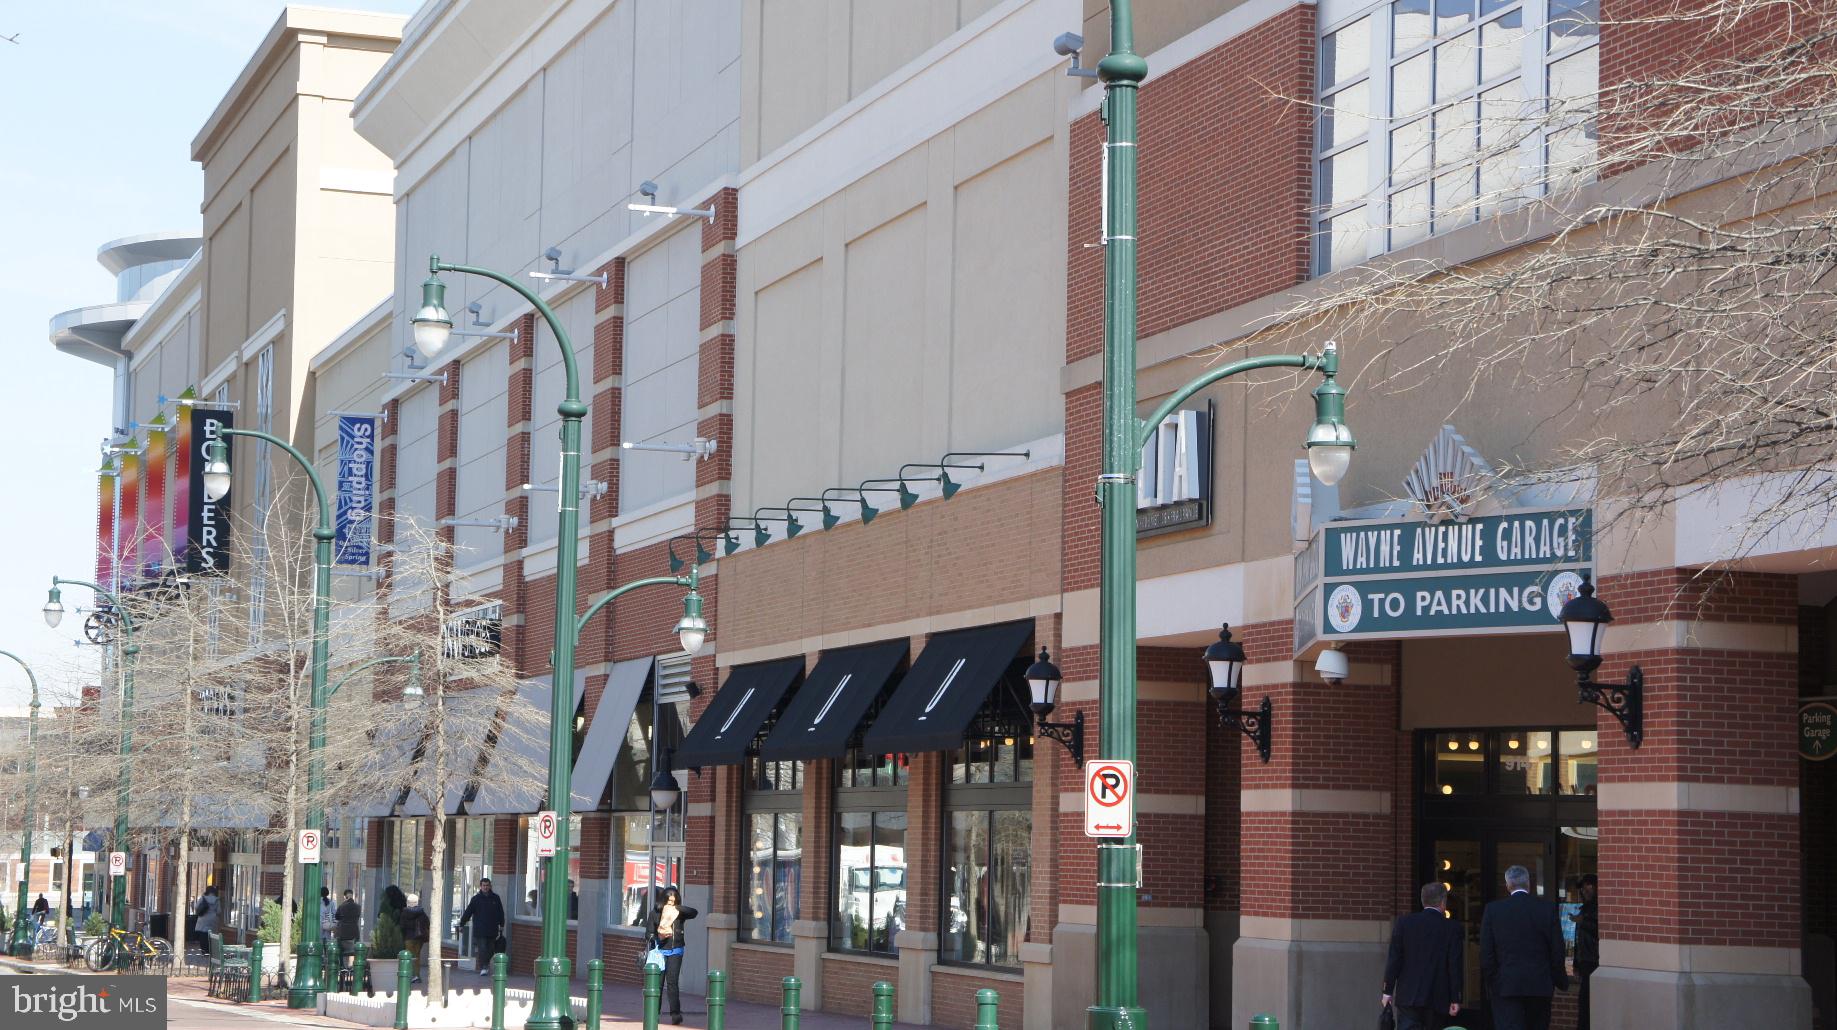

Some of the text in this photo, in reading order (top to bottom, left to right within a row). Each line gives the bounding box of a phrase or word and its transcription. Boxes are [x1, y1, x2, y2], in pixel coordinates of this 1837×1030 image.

[346, 423, 372, 521] Shopping
[1340, 529, 1402, 570] WAYNE
[1412, 523, 1484, 566] AVENUE
[1496, 517, 1577, 561] GARAGE
[1367, 592, 1405, 618] TO
[1416, 585, 1542, 616] PARKING
[1803, 712, 1832, 726] Parking
[1803, 726, 1831, 739] Garage
